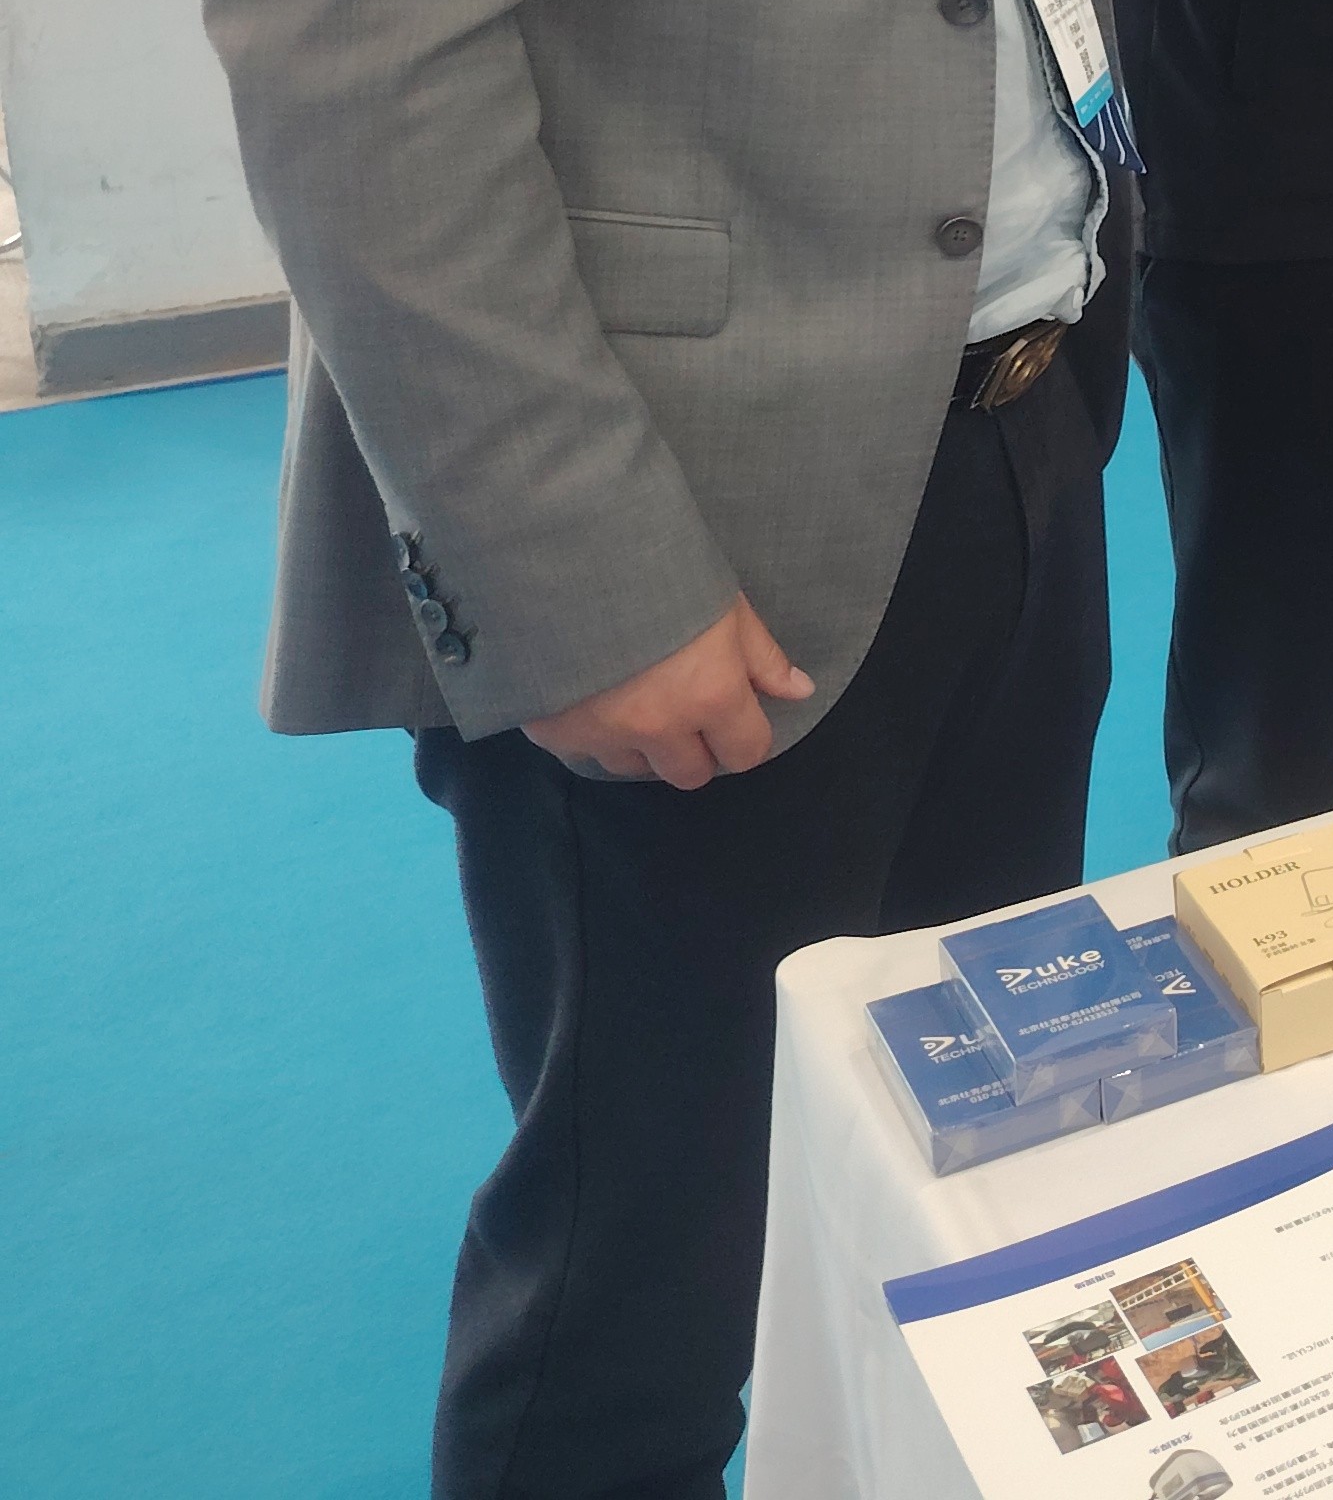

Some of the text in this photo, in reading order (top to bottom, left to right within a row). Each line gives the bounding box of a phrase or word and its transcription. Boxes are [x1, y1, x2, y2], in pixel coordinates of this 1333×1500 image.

[1208, 861, 1301, 894] HOLDER
[1253, 930, 1288, 947] k93
[1007, 960, 1105, 996] TECHNOLOGY
[1146, 1431, 1194, 1457] 无线探头
